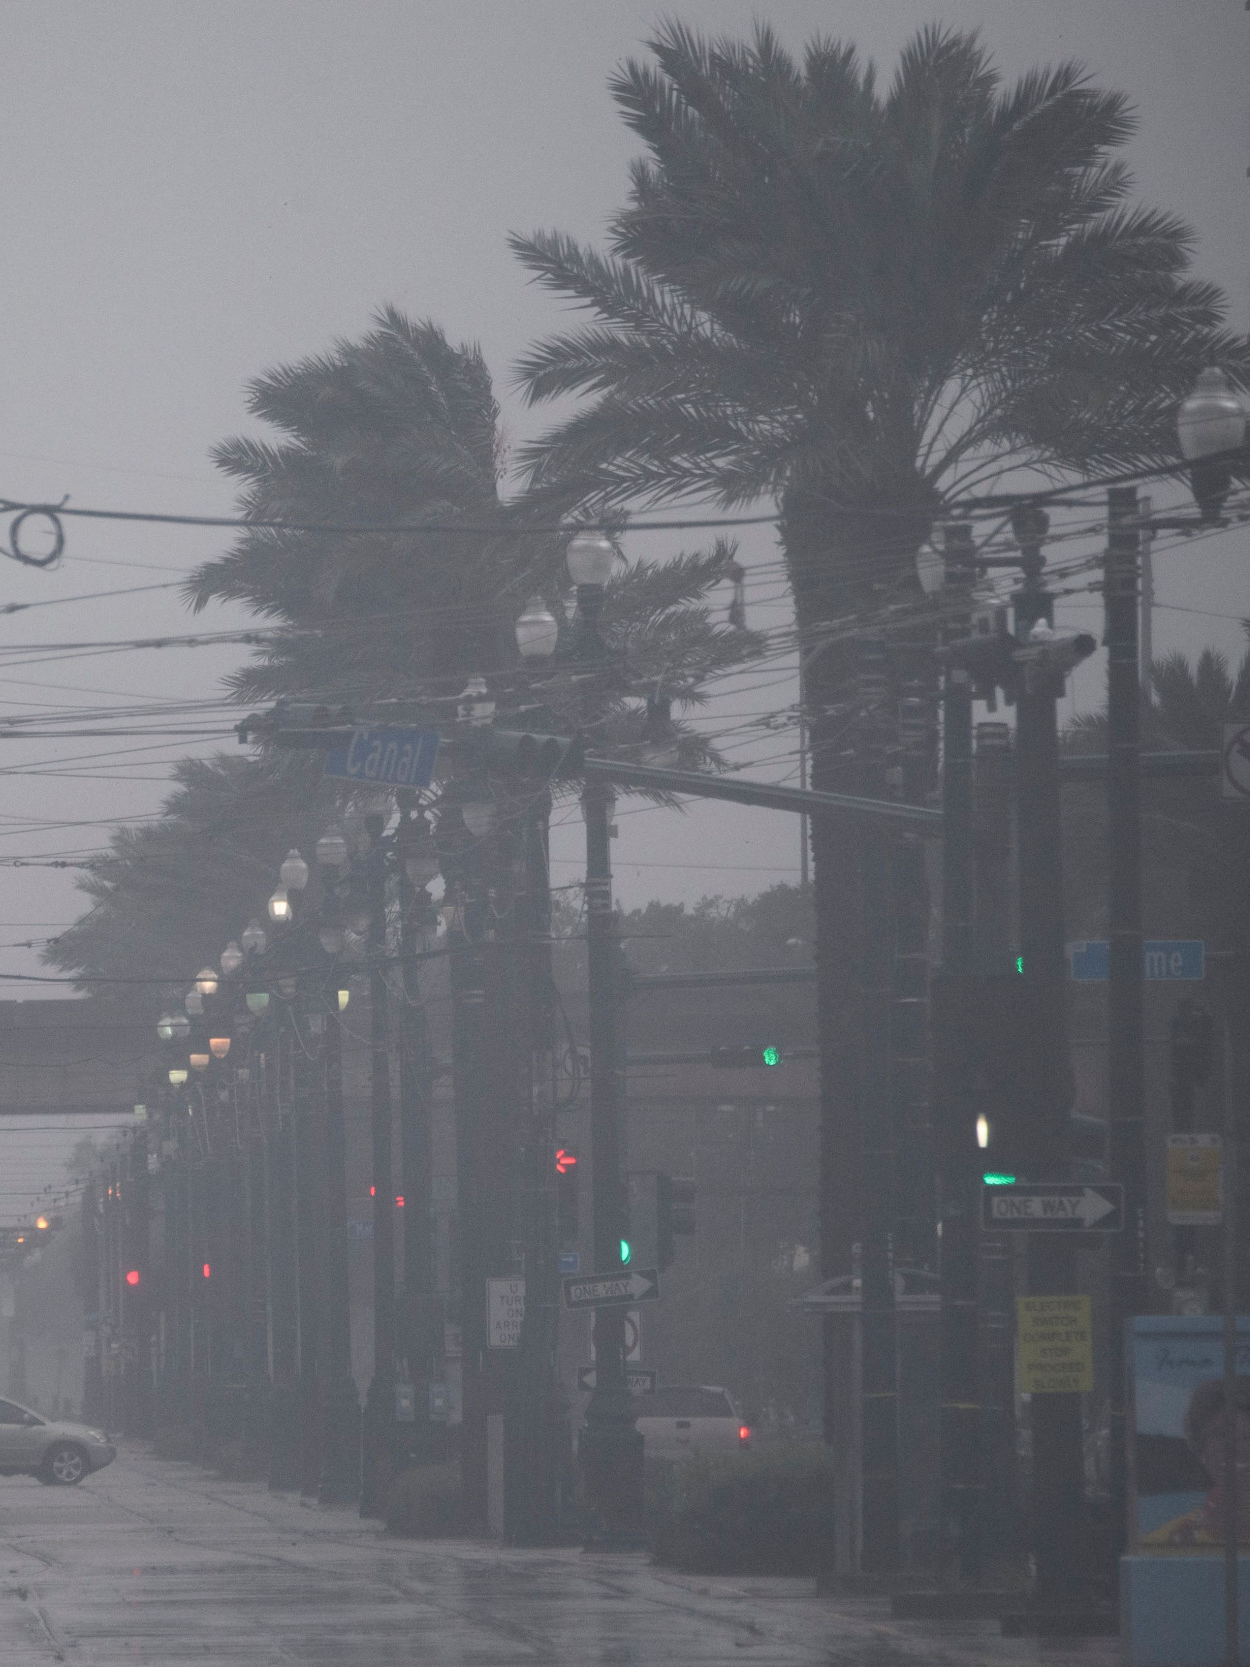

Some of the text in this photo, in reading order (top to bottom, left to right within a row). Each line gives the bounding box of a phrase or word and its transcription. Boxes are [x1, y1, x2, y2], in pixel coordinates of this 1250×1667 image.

[346, 730, 423, 783] Canal
[997, 1198, 1081, 1217] ONE WAY
[509, 1283, 519, 1294] U
[574, 1280, 630, 1300] ONE WAY
[499, 1295, 522, 1306] TUR
[1024, 1300, 1082, 1312] ELECTRIC
[506, 1308, 523, 1318] ON
[495, 1321, 519, 1331] ARR
[1032, 1316, 1078, 1327] SWITCH
[499, 1333, 516, 1343] ON
[1023, 1331, 1088, 1343] COMPLETE
[1040, 1347, 1071, 1358] STOP
[1027, 1363, 1086, 1374] PROCEED
[1033, 1376, 1080, 1389] SLOWLY
